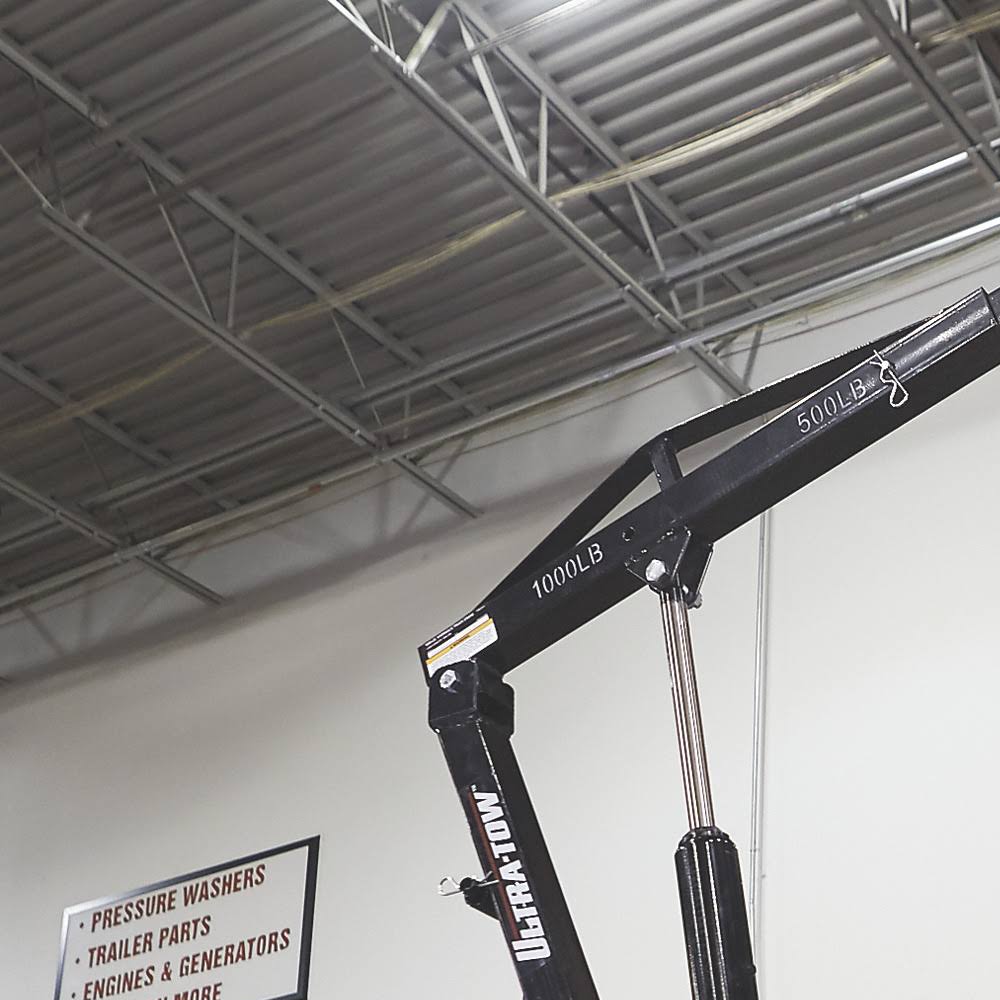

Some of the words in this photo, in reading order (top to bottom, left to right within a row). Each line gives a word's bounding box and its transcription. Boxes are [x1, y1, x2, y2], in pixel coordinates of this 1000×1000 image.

[797, 378, 867, 434] 500LB
[532, 542, 604, 599] 1000LB
[91, 890, 177, 932] PRESSURE
[183, 864, 266, 906] WASHERS
[88, 932, 153, 968] TRAILER
[158, 915, 211, 948] PARTS
[160, 961, 172, 982] &
[179, 928, 291, 977] GENERATORS
